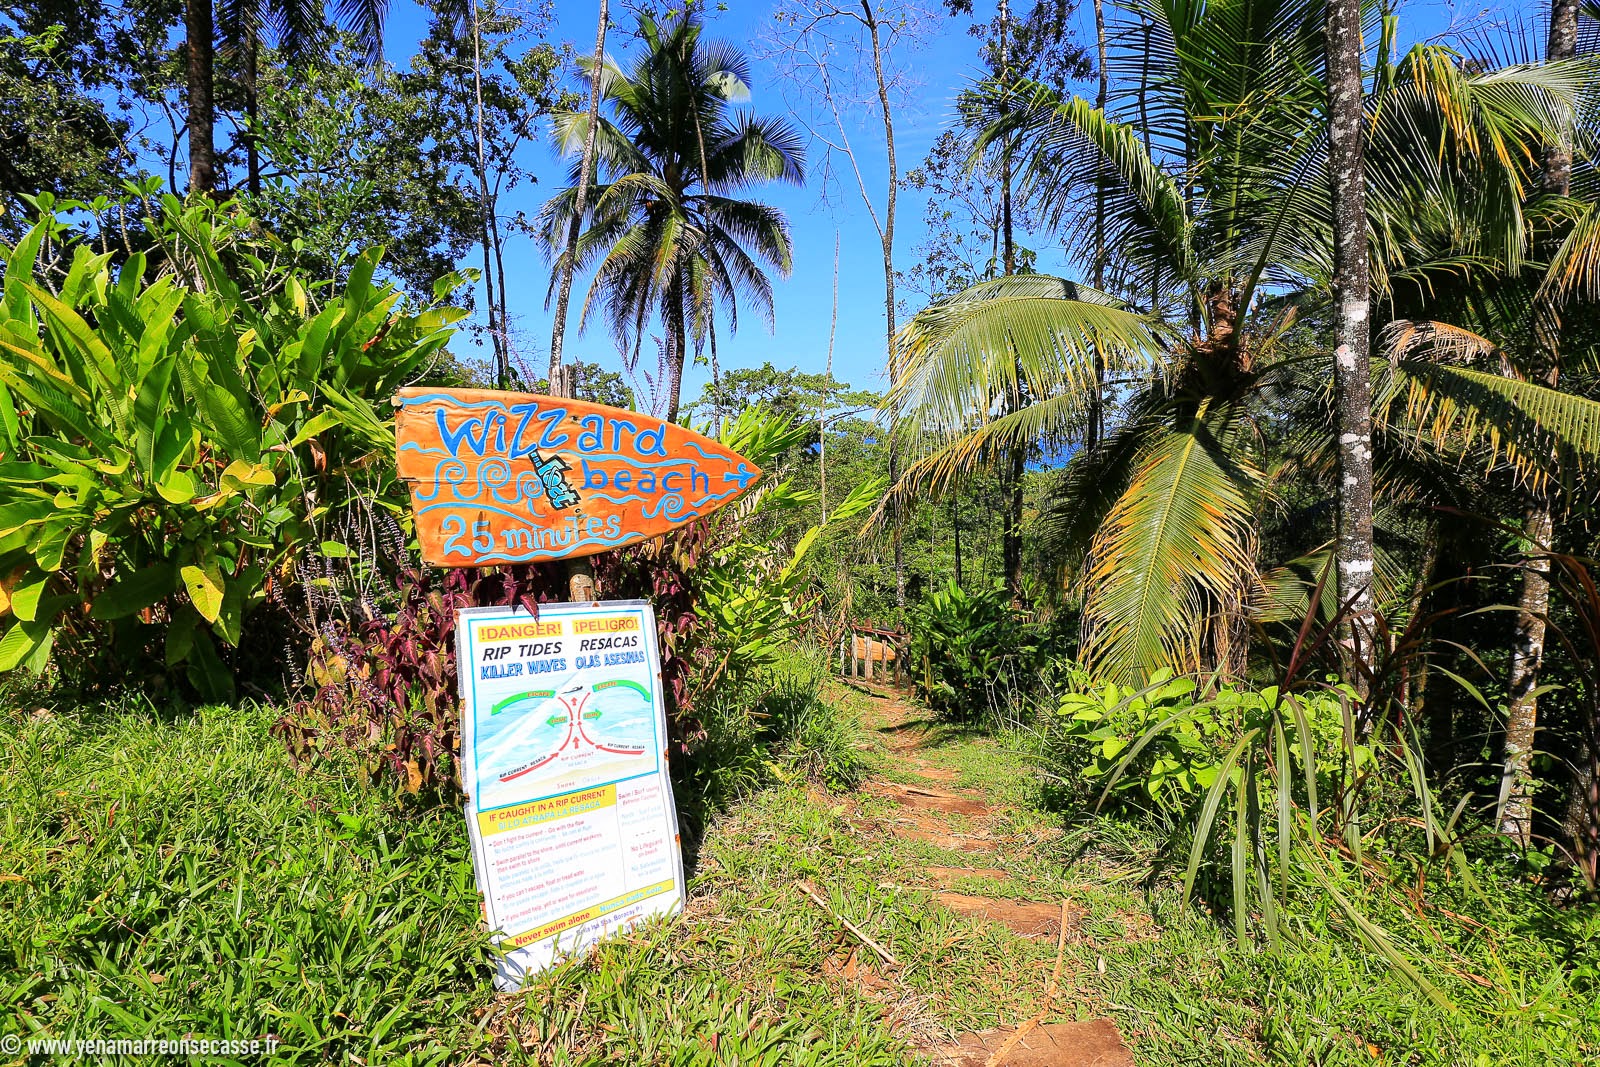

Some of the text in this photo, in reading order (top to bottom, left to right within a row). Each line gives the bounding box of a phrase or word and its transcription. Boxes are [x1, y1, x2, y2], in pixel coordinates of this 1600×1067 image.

[580, 457, 709, 494] beach
[442, 514, 621, 557] 25 minutes
[482, 642, 562, 662] RIP TIDES
[580, 636, 638, 652] RESACAS
[480, 658, 567, 680] KILLER WAVES
[575, 651, 645, 670] OLAS ASESINAS
[508, 764, 528, 776] CURRENT
[490, 814, 496, 822] IF
[499, 806, 535, 820] CAUGHT
[538, 803, 546, 811] IN
[556, 798, 568, 807] RIP
[570, 790, 606, 804] CURRENT
[522, 812, 555, 824] ATRAPA
[558, 808, 568, 816] LA
[570, 800, 600, 814] RESACA
[515, 931, 541, 946] Never
[544, 922, 566, 935] swim
[568, 912, 590, 925] alone
[600, 900, 624, 912] Nunca
